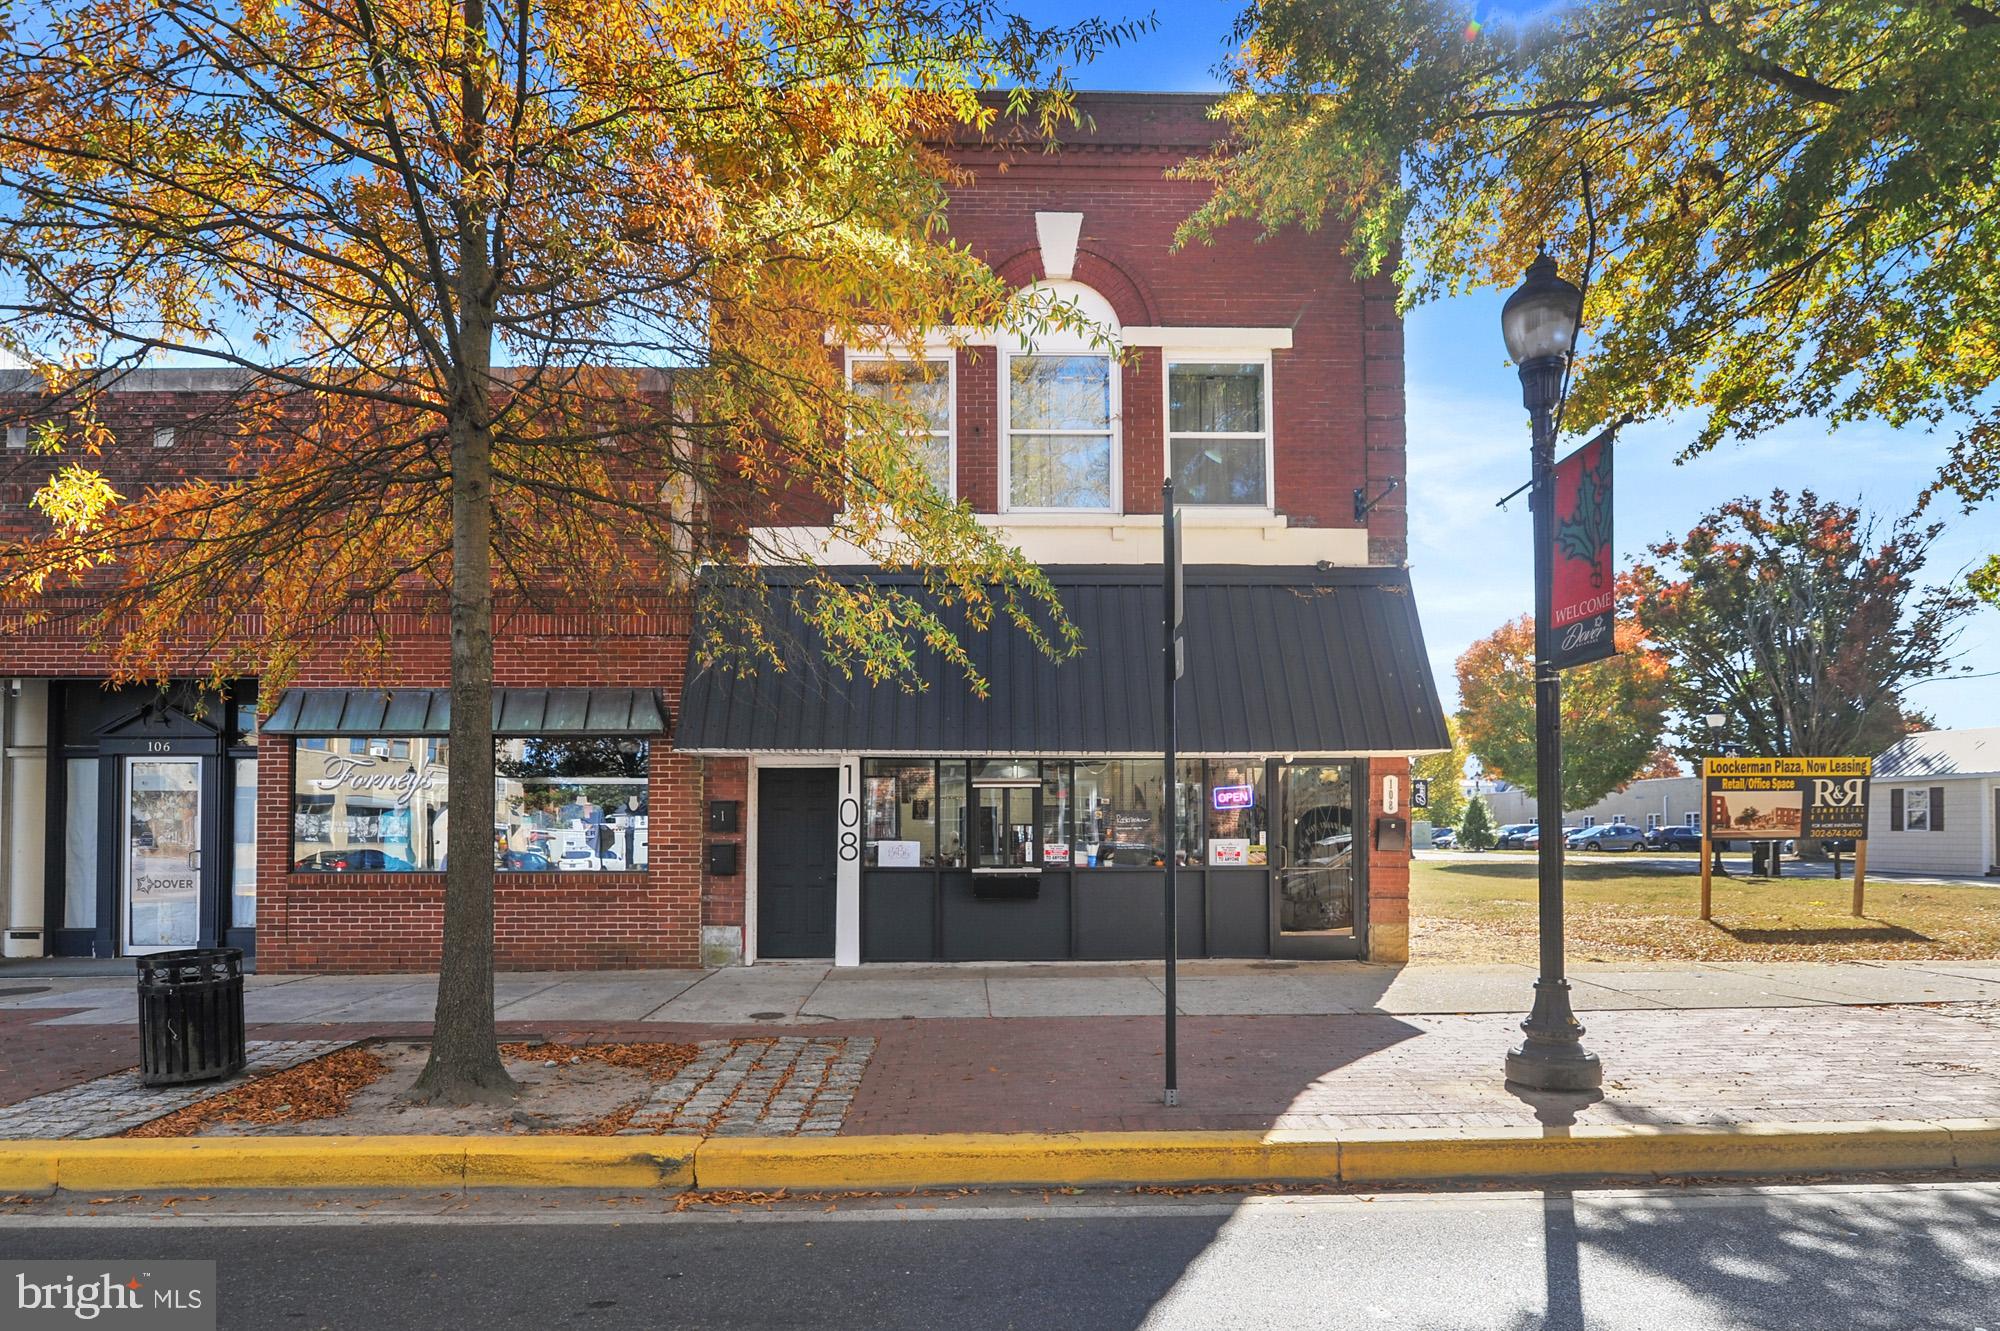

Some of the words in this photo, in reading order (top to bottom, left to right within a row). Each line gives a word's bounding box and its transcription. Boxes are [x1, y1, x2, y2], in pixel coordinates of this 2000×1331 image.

[1555, 591, 1611, 623] WELCOME
[1561, 622, 1606, 651] Dover
[147, 741, 171, 752] 106
[1710, 760, 1772, 774] Loockerman
[1774, 759, 1804, 775] Plaza,
[1806, 759, 1827, 773] Now
[1829, 759, 1867, 775] Leasing
[1722, 777, 1770, 791] Retail/Office
[1772, 778, 1796, 791] Space
[1217, 790, 1249, 803] OPEN
[838, 764, 859, 861] 108
[154, 879, 194, 889] DOVER
